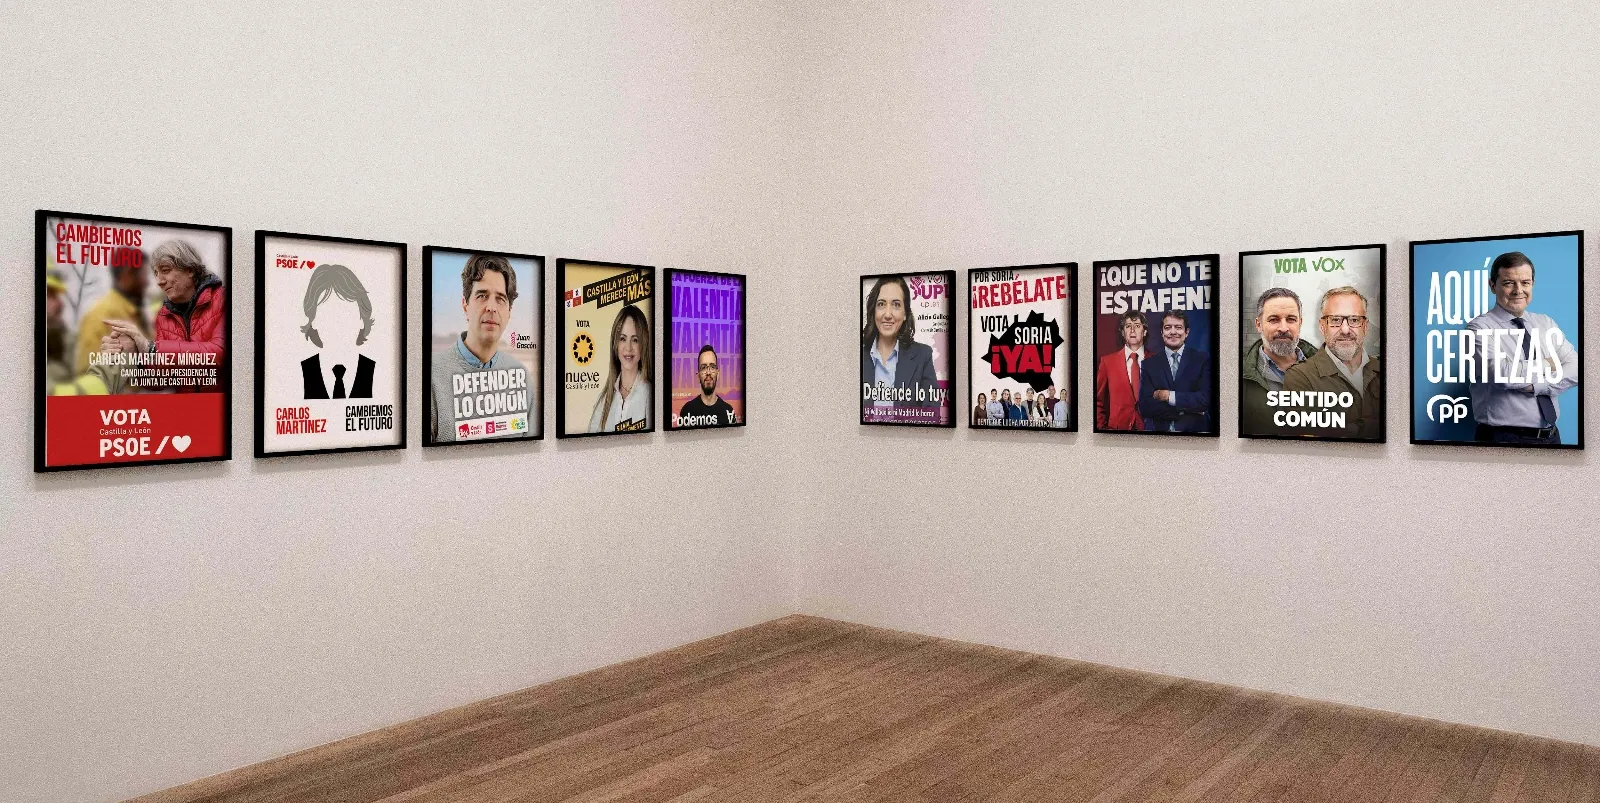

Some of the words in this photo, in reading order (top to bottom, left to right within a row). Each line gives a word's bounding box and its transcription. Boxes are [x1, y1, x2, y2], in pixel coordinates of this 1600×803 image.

[56, 223, 142, 247] CAMBIEMOS
[56, 243, 76, 264] EL
[81, 245, 143, 269] FUTURO
[276, 259, 298, 269] PSOE
[1274, 257, 1308, 274] VOTA
[1311, 256, 1346, 273] VOX
[683, 273, 719, 285] FUERZA
[974, 272, 989, 283] POR
[991, 270, 1014, 282] SORIA
[1100, 264, 1147, 287] ¡QUE
[1151, 262, 1182, 284] NO
[1186, 260, 1212, 281] TE
[586, 280, 617, 298] CASTILLA
[617, 278, 623, 288] Y
[623, 272, 639, 287] LEÓN
[600, 287, 627, 305] MERECE
[627, 277, 651, 302] MÁS
[972, 274, 1067, 309] ¡REBÉLATE
[1426, 256, 1492, 326] AQUÍ
[1100, 285, 1212, 315] ESTAFEN!
[576, 320, 590, 328] VOTA
[980, 315, 1009, 333] VOTA
[1014, 326, 1053, 345] SORIA
[88, 352, 127, 366] CARLOS
[128, 350, 176, 366] MARTÍNEZ
[177, 350, 217, 366] MÍNGUEZ
[991, 344, 1053, 374] ¡YA!
[1426, 327, 1564, 385] CERTEZAS
[120, 369, 155, 377] CANDIDATO
[162, 369, 169, 377] LA
[170, 369, 208, 377] PRESIDENCIA
[209, 369, 217, 377] DE
[130, 378, 139, 387] LA
[139, 378, 159, 387] JUNTA
[160, 378, 168, 386] DE
[168, 378, 196, 386] CASTILLA
[196, 378, 201, 386] Y
[202, 376, 217, 386] LEÓN
[453, 369, 527, 395] DEFENDER
[566, 371, 600, 383] nueve
[863, 382, 912, 402] Defiende
[915, 382, 926, 402] lo
[1265, 390, 1354, 408] SENTIDO
[345, 405, 393, 417] CAMBIEMOS
[454, 396, 474, 419] LO
[476, 390, 528, 416] COMÚN
[100, 409, 151, 425] VOTA
[276, 407, 310, 421] CARLOS
[1273, 408, 1346, 428] COMÚN
[100, 428, 127, 436] Castilla
[134, 427, 151, 435] León
[345, 419, 357, 431] EL
[359, 417, 393, 431] FUTURO
[100, 437, 151, 457] PSOE
